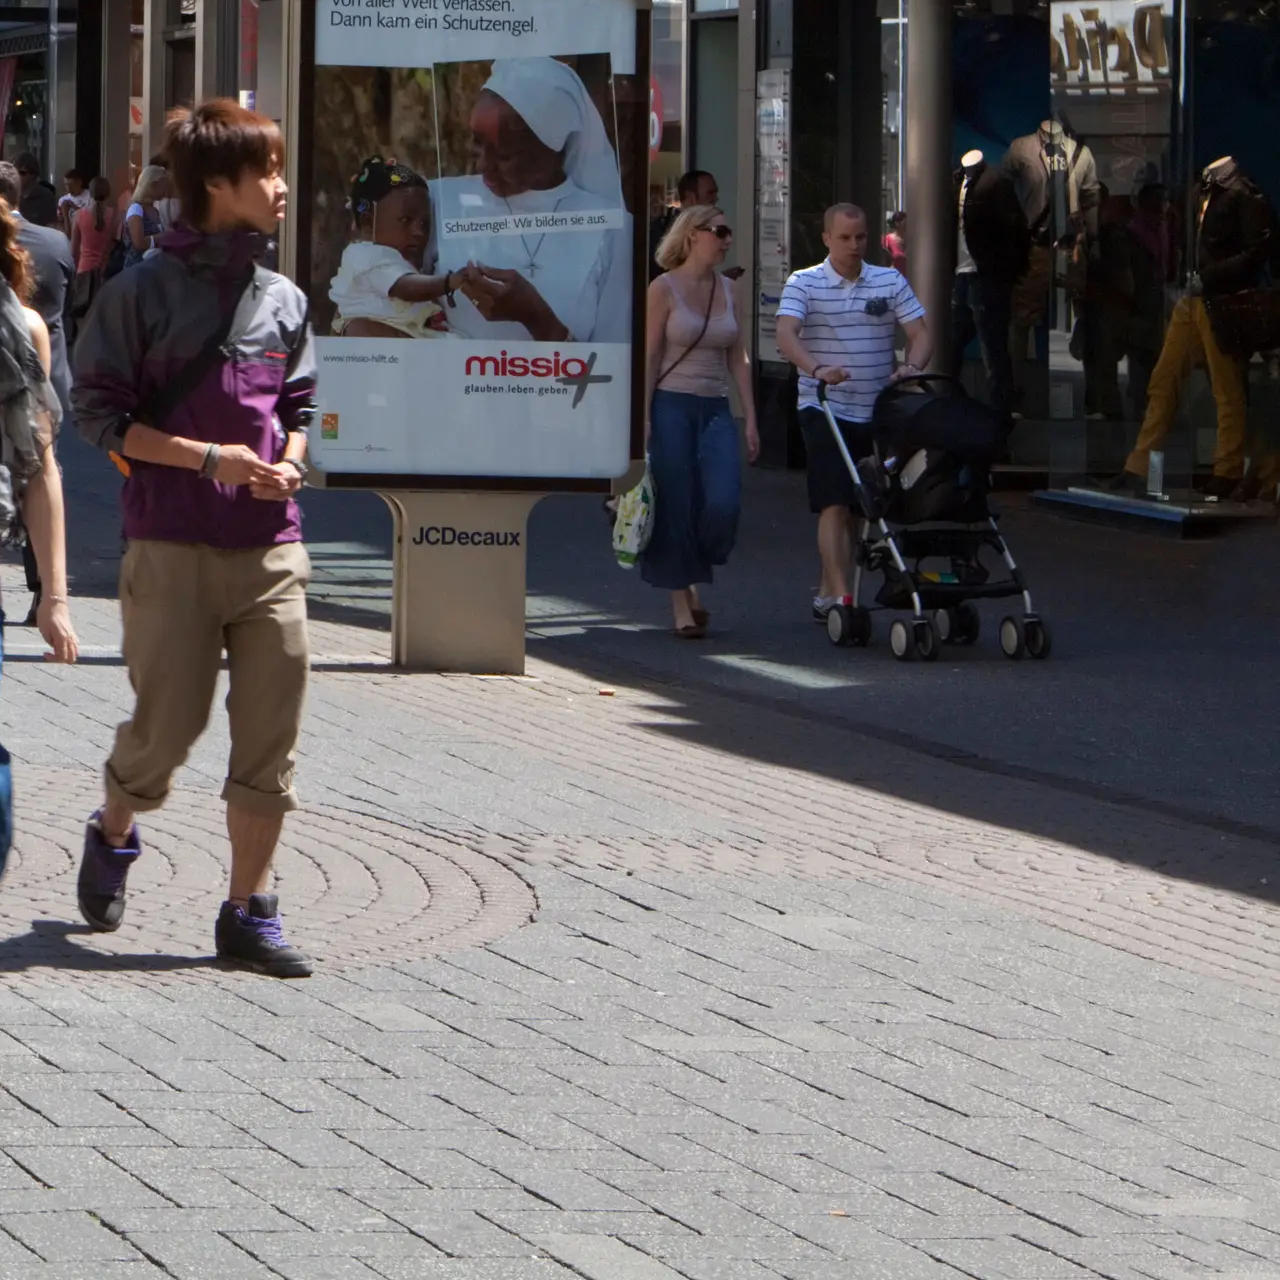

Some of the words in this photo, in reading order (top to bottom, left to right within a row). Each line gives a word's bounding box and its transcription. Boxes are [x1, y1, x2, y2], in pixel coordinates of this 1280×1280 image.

[330, 11, 372, 28] Dann
[376, 11, 410, 29] kam
[414, 13, 438, 30] ein
[442, 14, 538, 36] Schutzengel.
[445, 219, 511, 234] Schutzengel:
[513, 218, 532, 229] Wir
[535, 215, 568, 228] bilden
[571, 214, 584, 226] sie
[586, 215, 608, 225] aus.
[323, 352, 400, 365] www.missio-hilft.de
[464, 350, 588, 379] missio
[411, 526, 521, 547] JCDecaux
